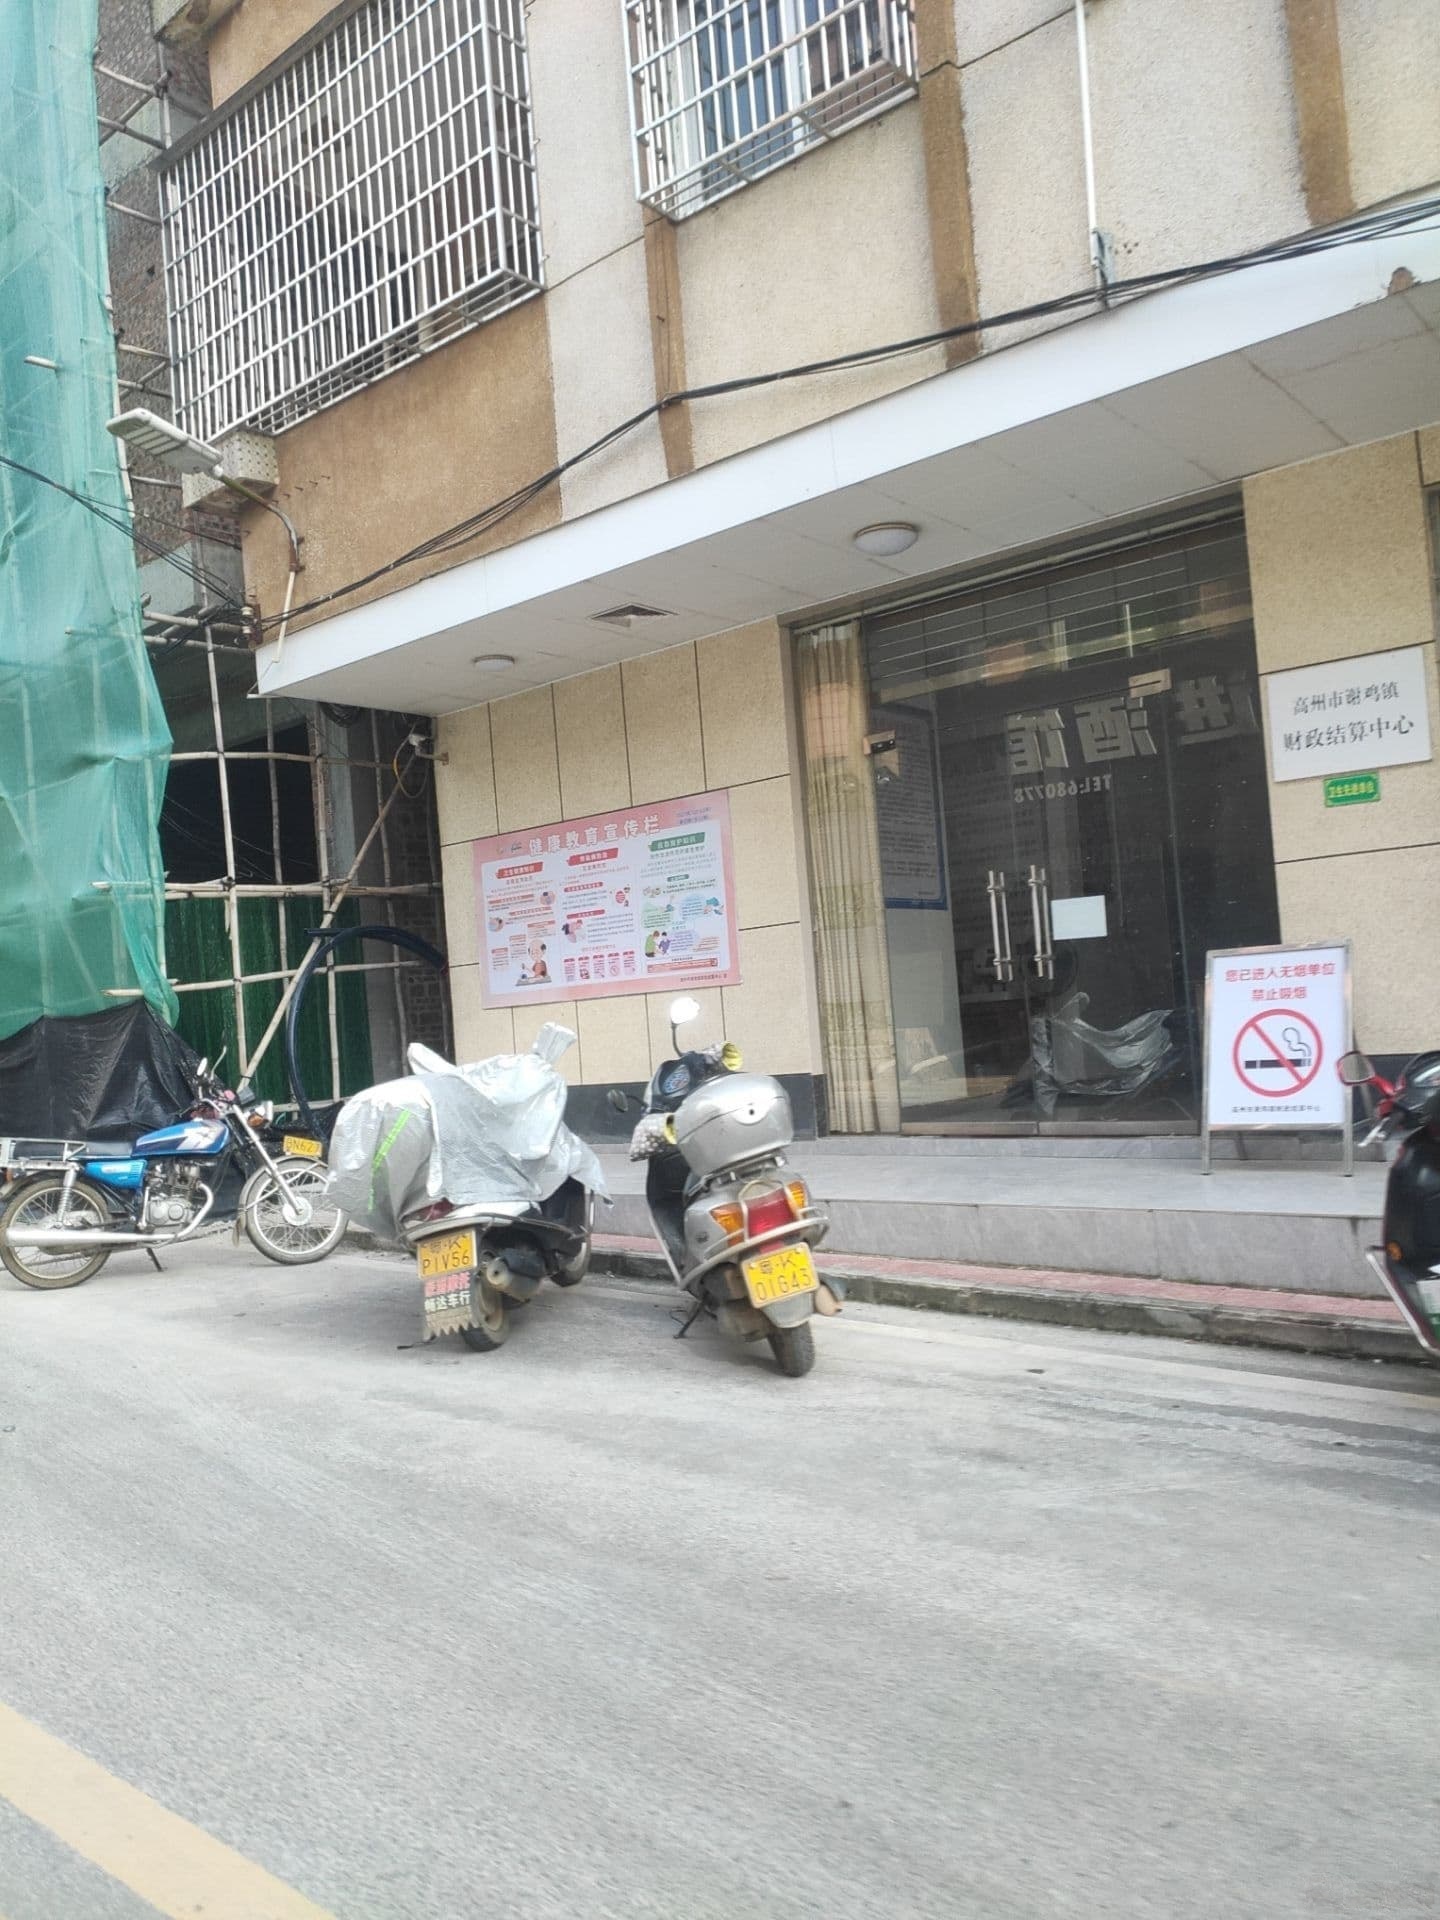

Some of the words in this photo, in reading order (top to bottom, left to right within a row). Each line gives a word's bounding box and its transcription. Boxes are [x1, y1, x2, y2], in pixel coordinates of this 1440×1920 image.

[1283, 715, 1414, 751] 财政结算中心
[528, 815, 660, 857] 健康教育宣传栏
[1225, 962, 1336, 982] 您已进入无烟单位
[1251, 986, 1308, 1002] 禁止吸烟
